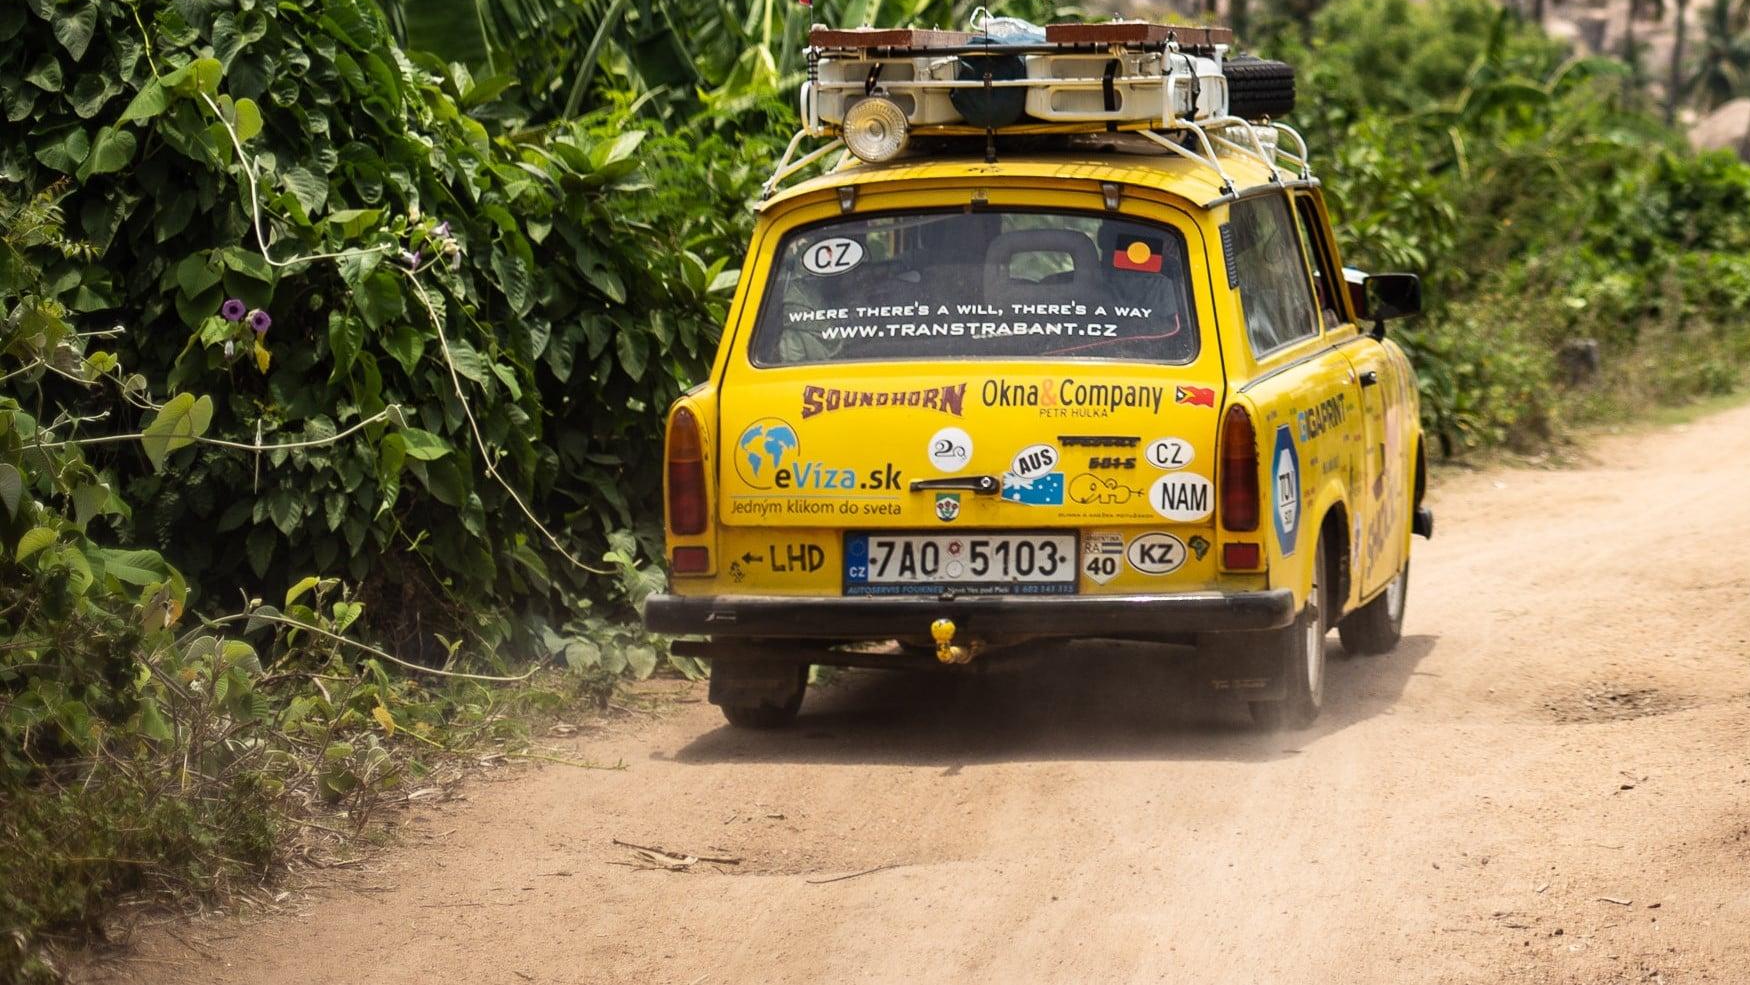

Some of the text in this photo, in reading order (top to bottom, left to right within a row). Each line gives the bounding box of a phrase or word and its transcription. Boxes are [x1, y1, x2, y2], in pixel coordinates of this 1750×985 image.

[814, 242, 851, 269] CZ
[788, 300, 1152, 322] WHERE THERE'S A WILL, THERE'S A WAY
[821, 322, 1118, 340] WWW.TRANSTRABANT.CZ
[801, 382, 967, 419] SOUNDHORN
[1039, 408, 1067, 418] PETR
[1018, 448, 1054, 475] AUS
[1155, 442, 1184, 465] CZ
[1161, 482, 1208, 511] NAM
[731, 499, 902, 517] Jedným klikom do sveta
[769, 543, 825, 573] LHD
[970, 540, 1058, 576] 5103
[1085, 542, 1100, 553] RA
[1139, 543, 1174, 564] KZ
[849, 567, 866, 578] CZ
[1086, 556, 1116, 576] 40
